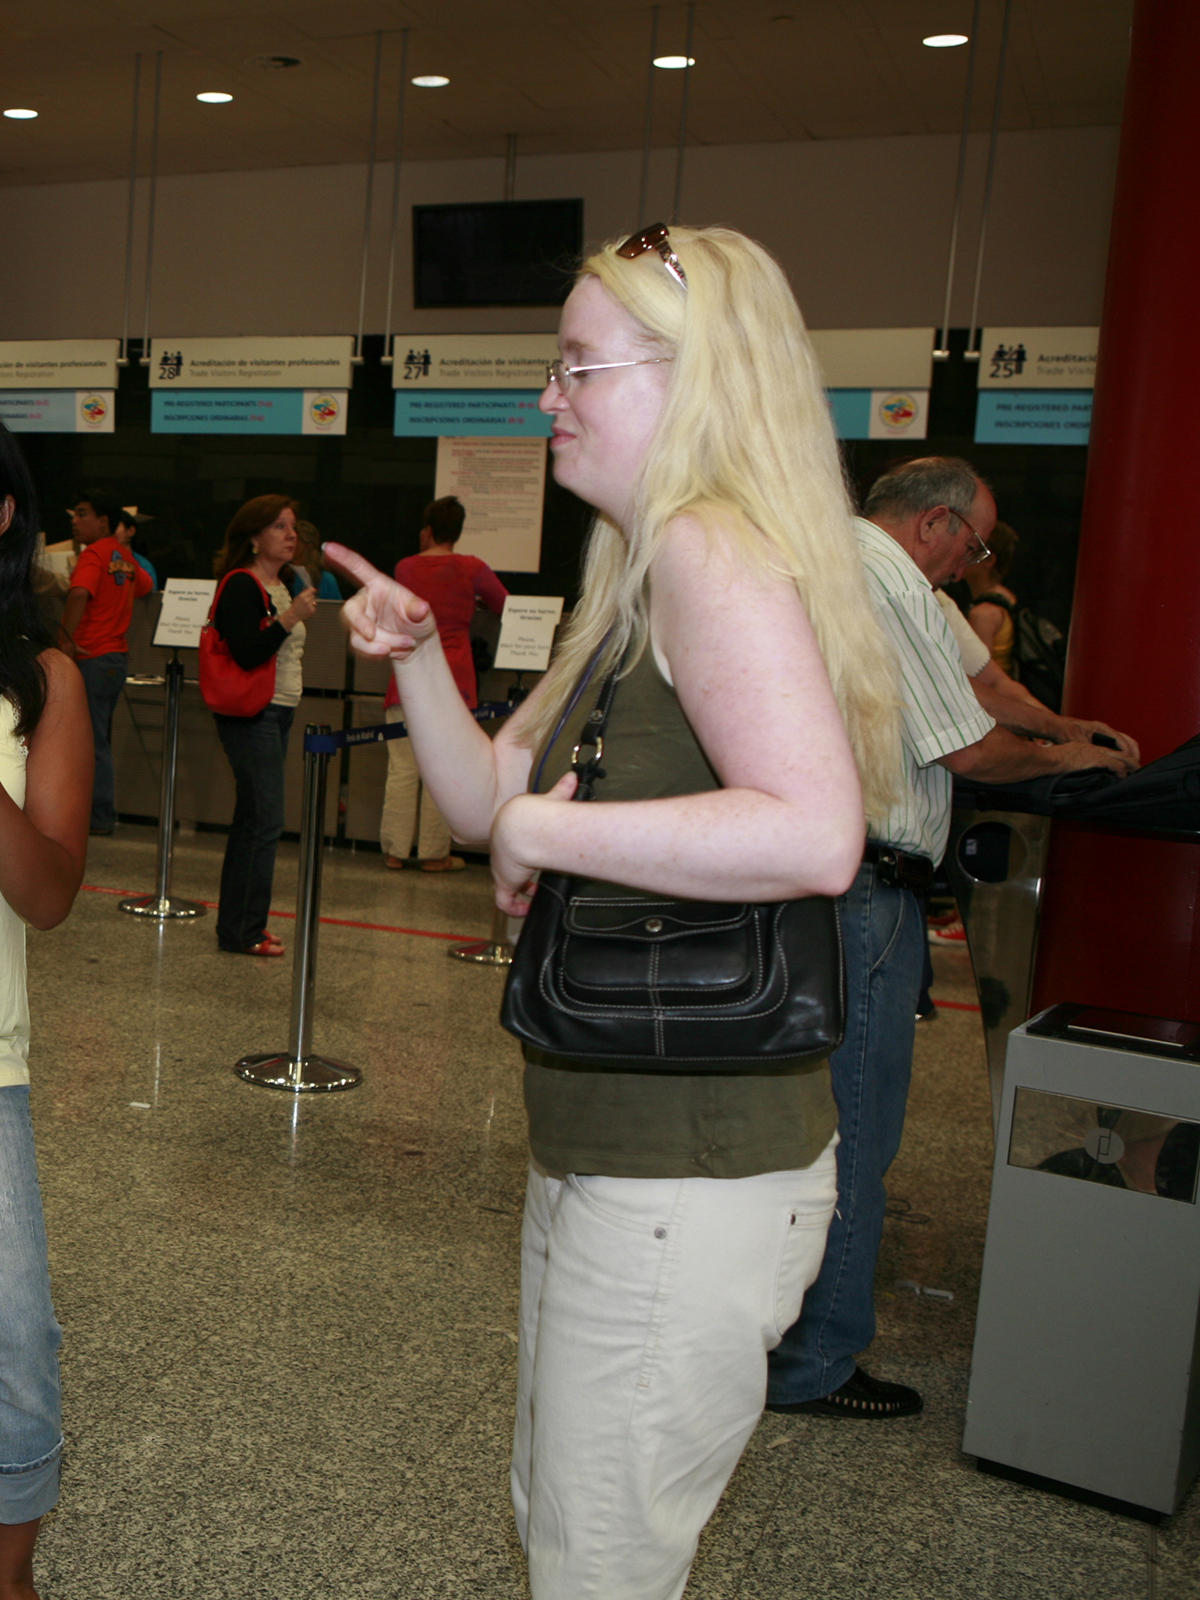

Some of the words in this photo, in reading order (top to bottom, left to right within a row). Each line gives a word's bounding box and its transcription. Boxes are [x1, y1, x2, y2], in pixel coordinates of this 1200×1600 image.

[238, 359, 248, 367] de
[250, 359, 286, 367] visitantes
[288, 359, 340, 368] profesionales
[495, 358, 506, 366] de
[159, 367, 176, 380] 28
[404, 366, 423, 380] 27
[989, 363, 1014, 378] 25
